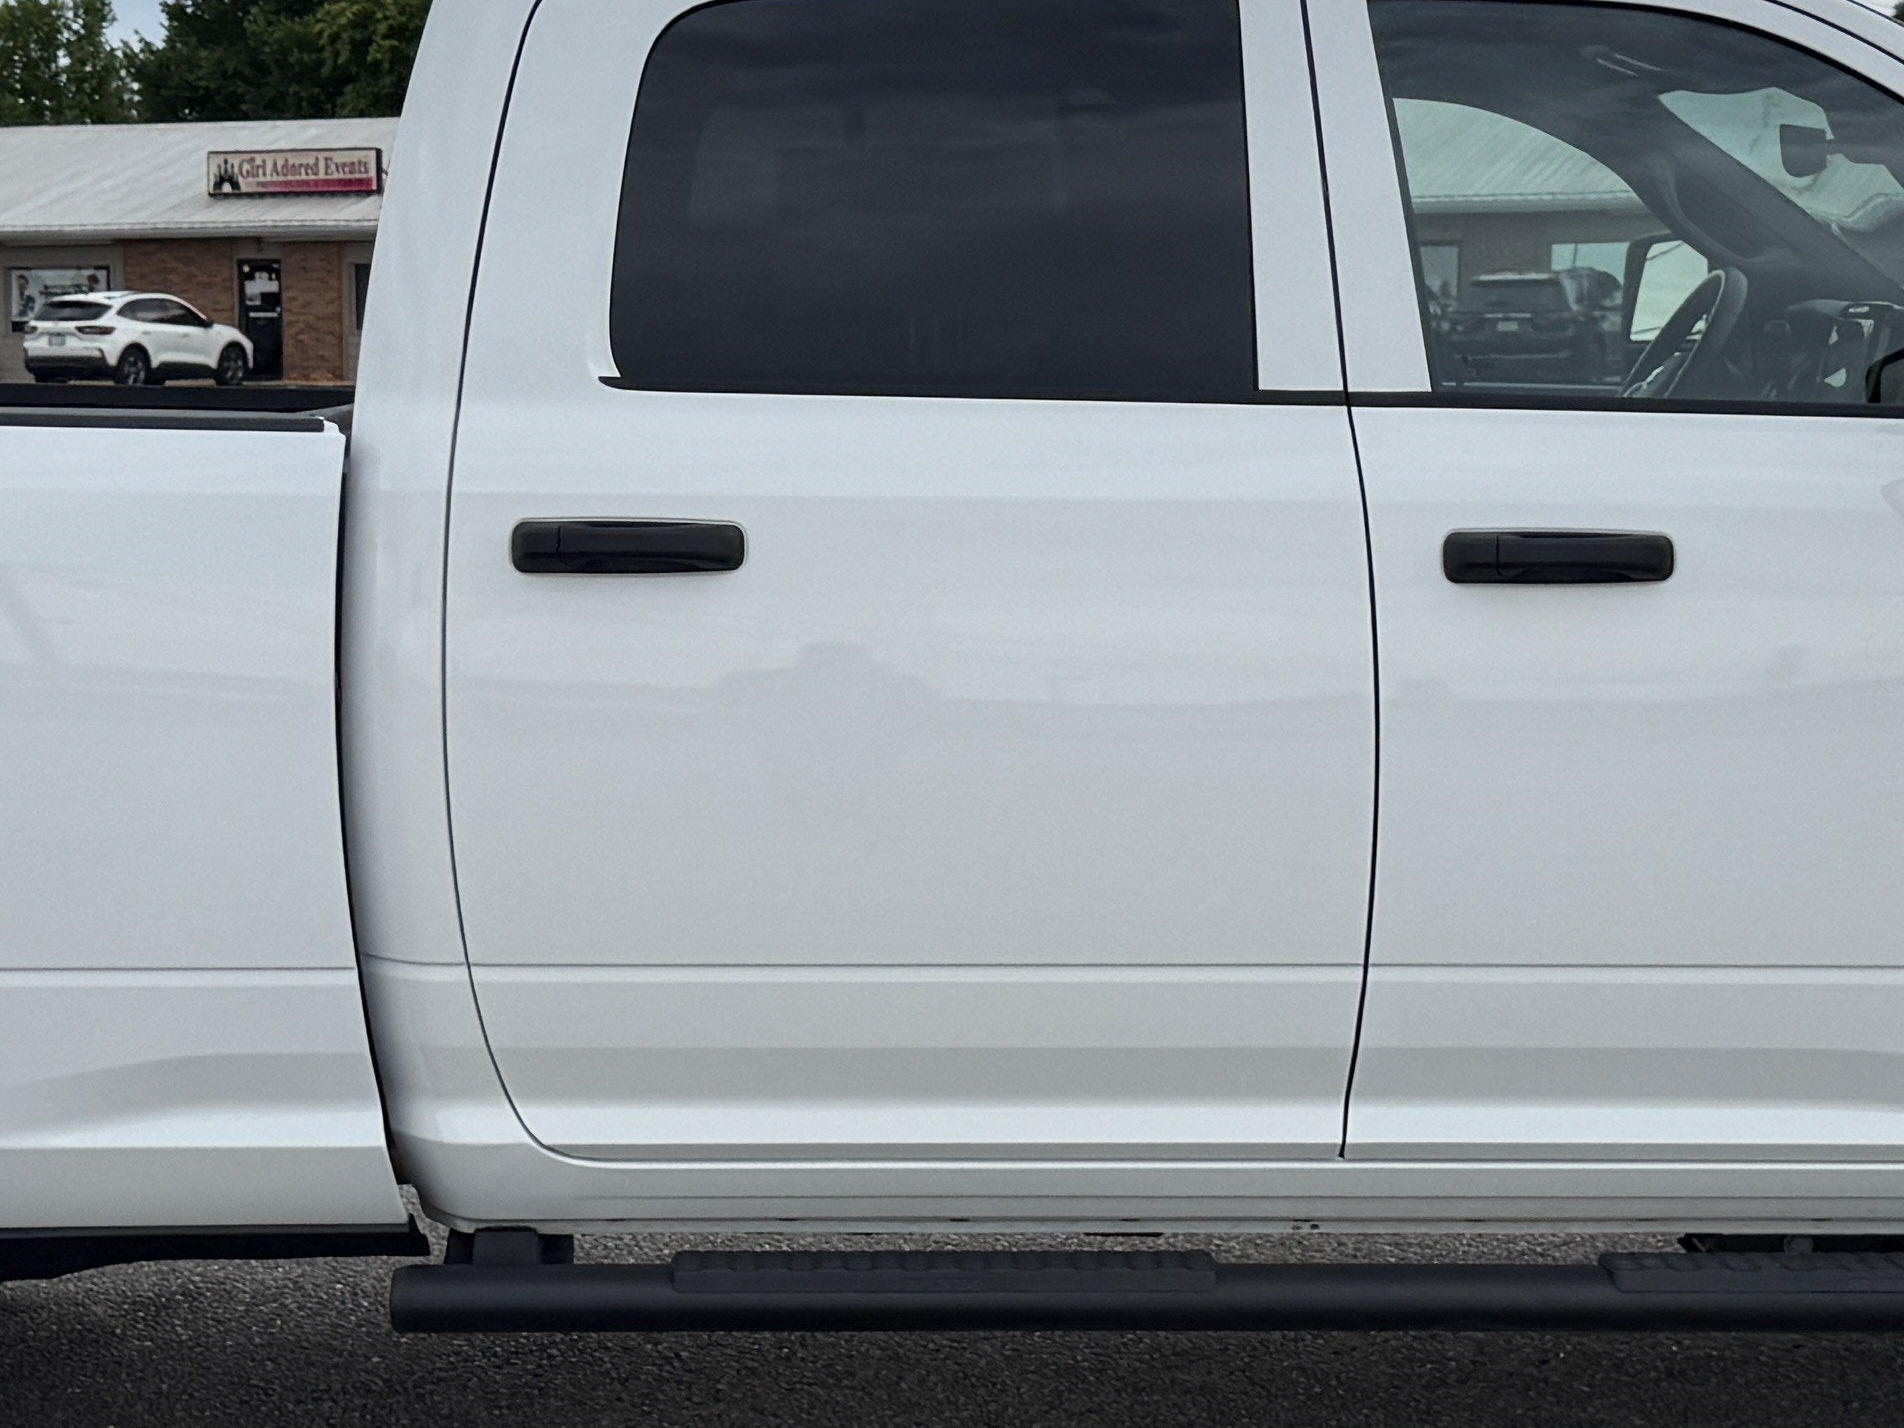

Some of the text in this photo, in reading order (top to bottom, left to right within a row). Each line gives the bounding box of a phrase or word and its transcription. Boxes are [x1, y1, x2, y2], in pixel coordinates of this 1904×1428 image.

[238, 156, 369, 179] Girl Adored Events
